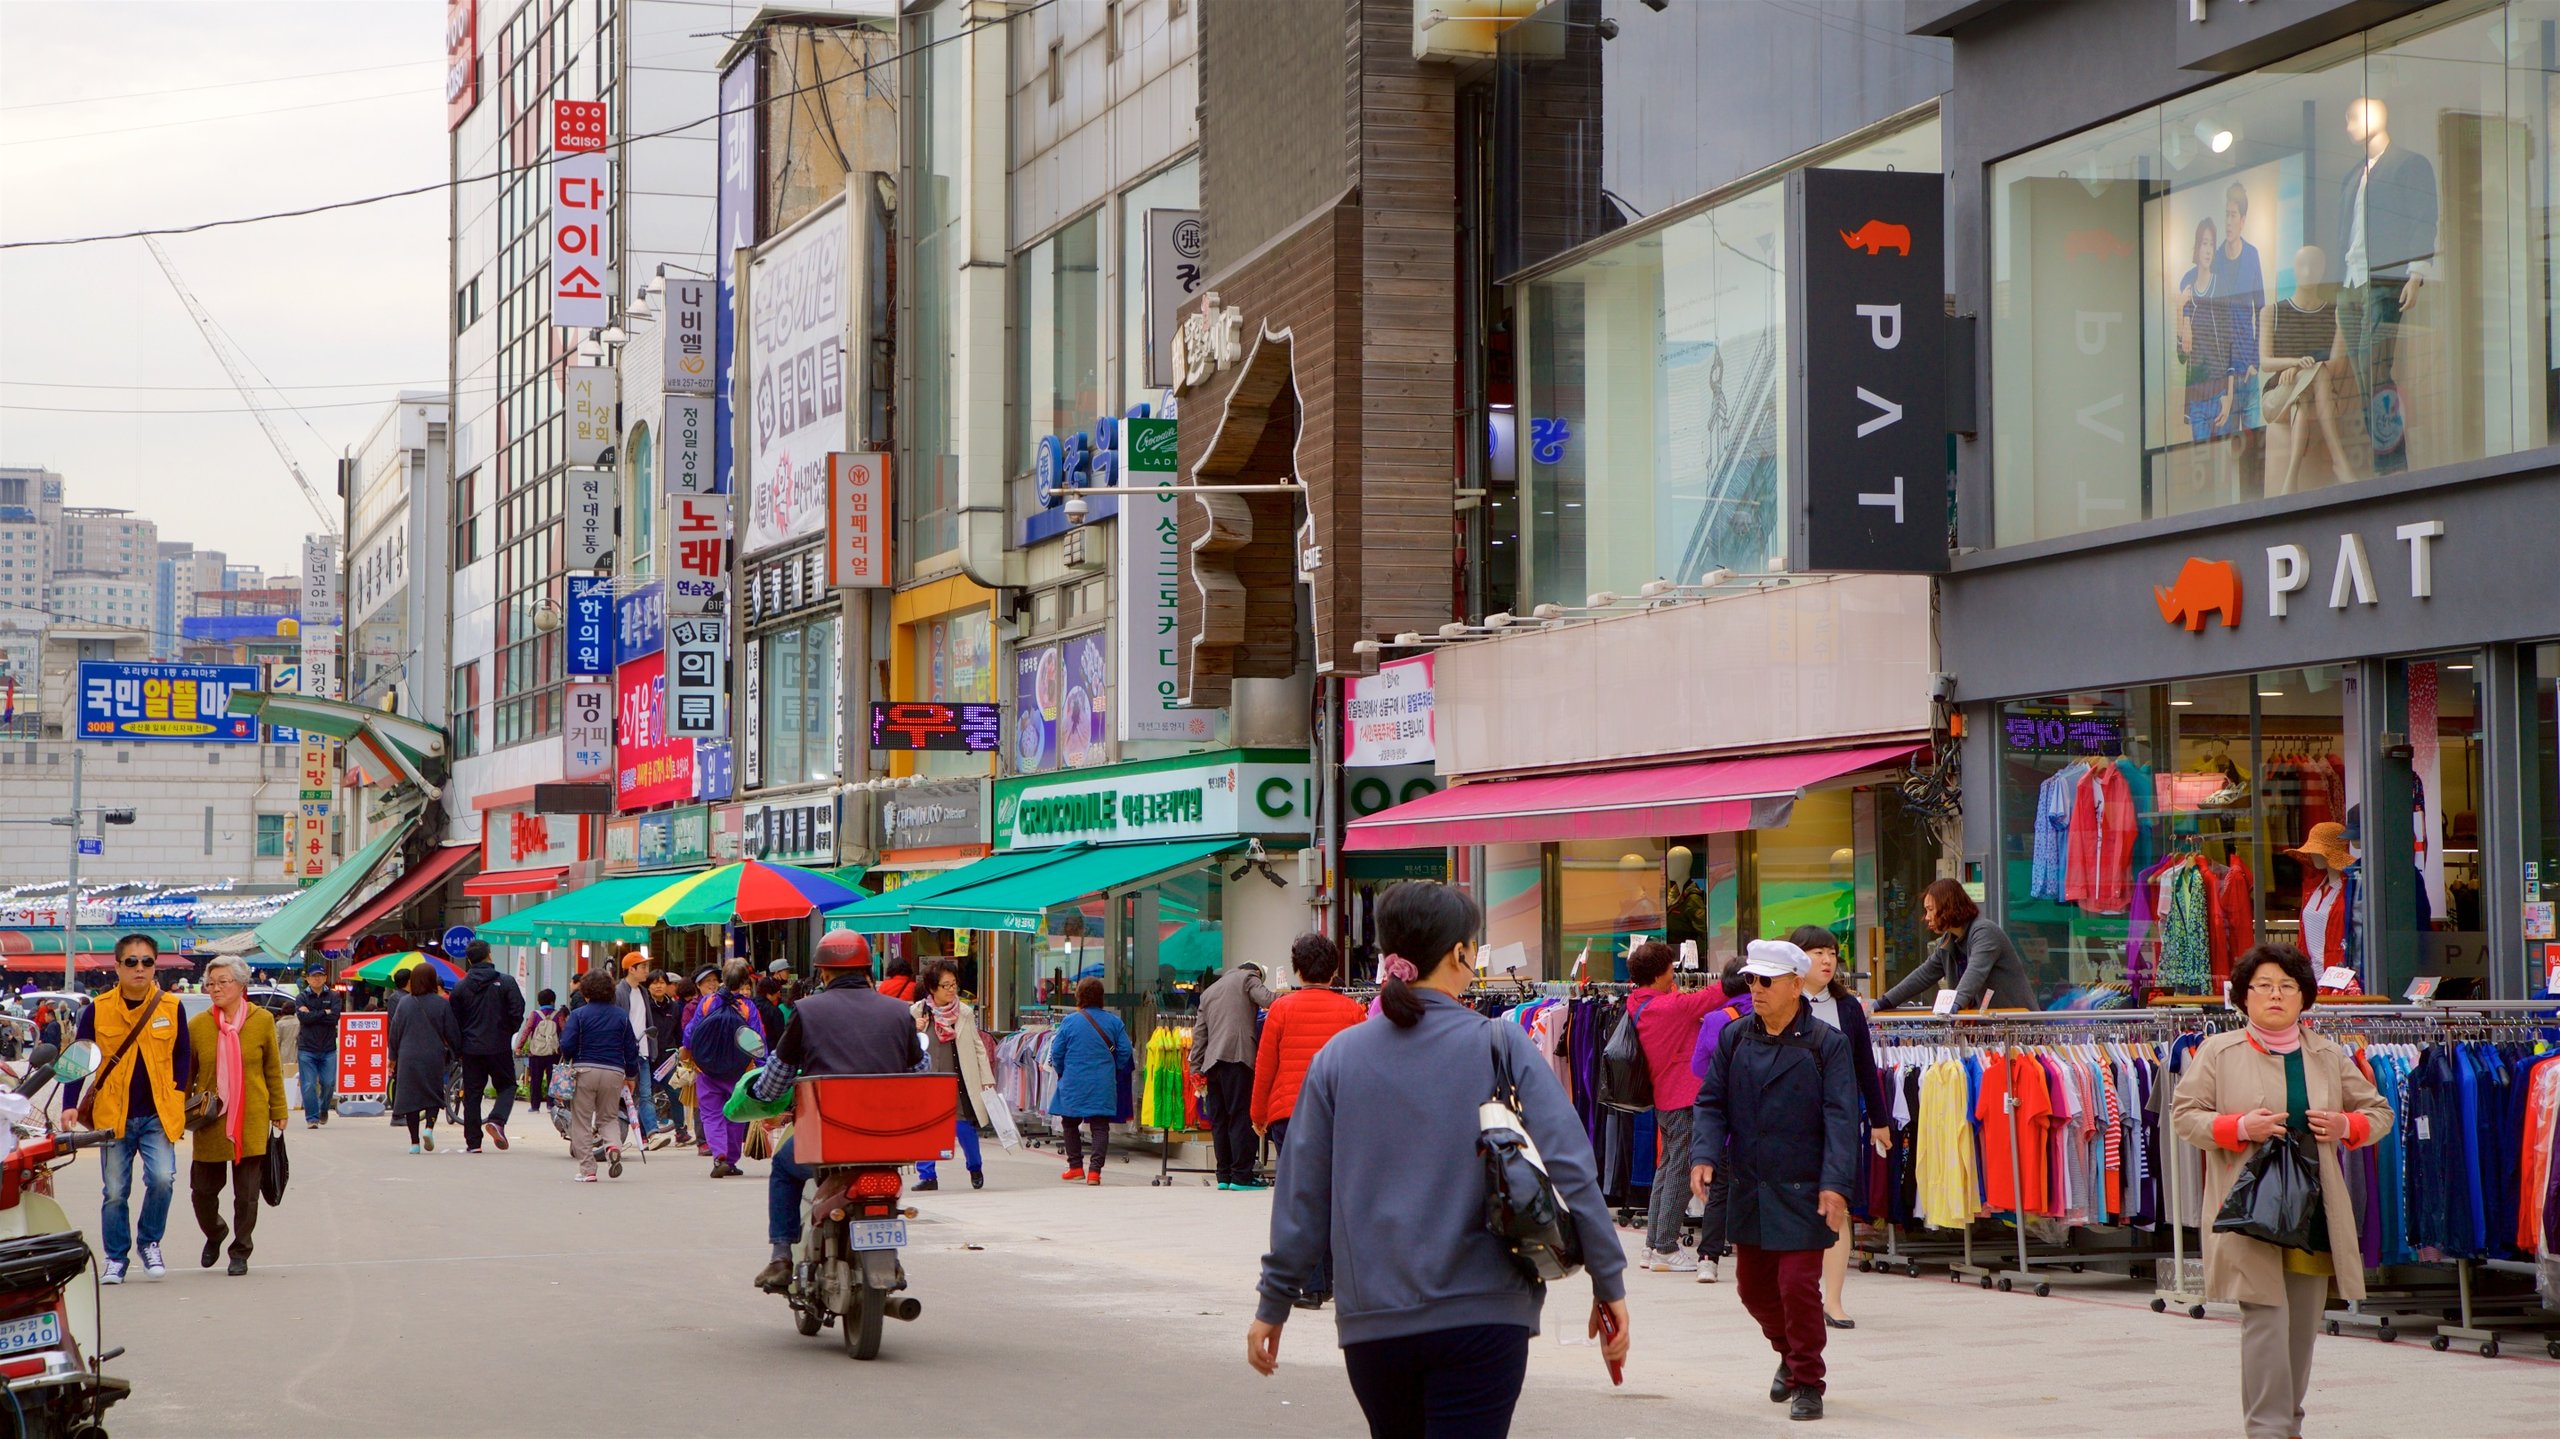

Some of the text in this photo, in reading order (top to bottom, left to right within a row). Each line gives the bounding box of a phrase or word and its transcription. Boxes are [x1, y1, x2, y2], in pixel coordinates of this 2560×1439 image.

[561, 133, 600, 147] daiso
[558, 178, 604, 299] 다이소
[755, 227, 842, 353] 확장개업
[680, 287, 703, 354] 나비엘
[682, 379, 713, 388] 257-6277
[758, 338, 842, 450] 명동의류
[577, 380, 592, 440] 사리원
[595, 406, 610, 444] 상회
[1857, 303, 1904, 523] PAT
[605, 453, 614, 462] 1F
[681, 408, 698, 491] 정일상회
[582, 480, 599, 554] 현대유통
[851, 493, 867, 576] 임페리얼
[678, 500, 721, 577] 노래
[312, 564, 327, 598] 네꼬야
[602, 558, 611, 567] 1F
[2266, 521, 2444, 617] PAT
[677, 580, 715, 596] 연습장
[708, 601, 724, 610] B1F
[752, 553, 824, 620] 명동의류
[578, 599, 602, 670] 한의원
[675, 622, 719, 645] 명동
[311, 663, 326, 699] 워킹
[681, 653, 711, 728] 의류
[87, 722, 115, 732] 300평
[235, 723, 245, 732] B1
[577, 693, 601, 723] 명
[570, 727, 607, 747] 커피
[576, 752, 602, 765] 맥주
[302, 804, 328, 817] 영동
[1019, 790, 1117, 835] CROCODILE
[1257, 777, 1437, 817] CO
[307, 819, 324, 875] 미용실
[756, 808, 808, 852] 명동의류
[345, 1034, 382, 1048] 허리
[867, 1231, 903, 1244] 1578
